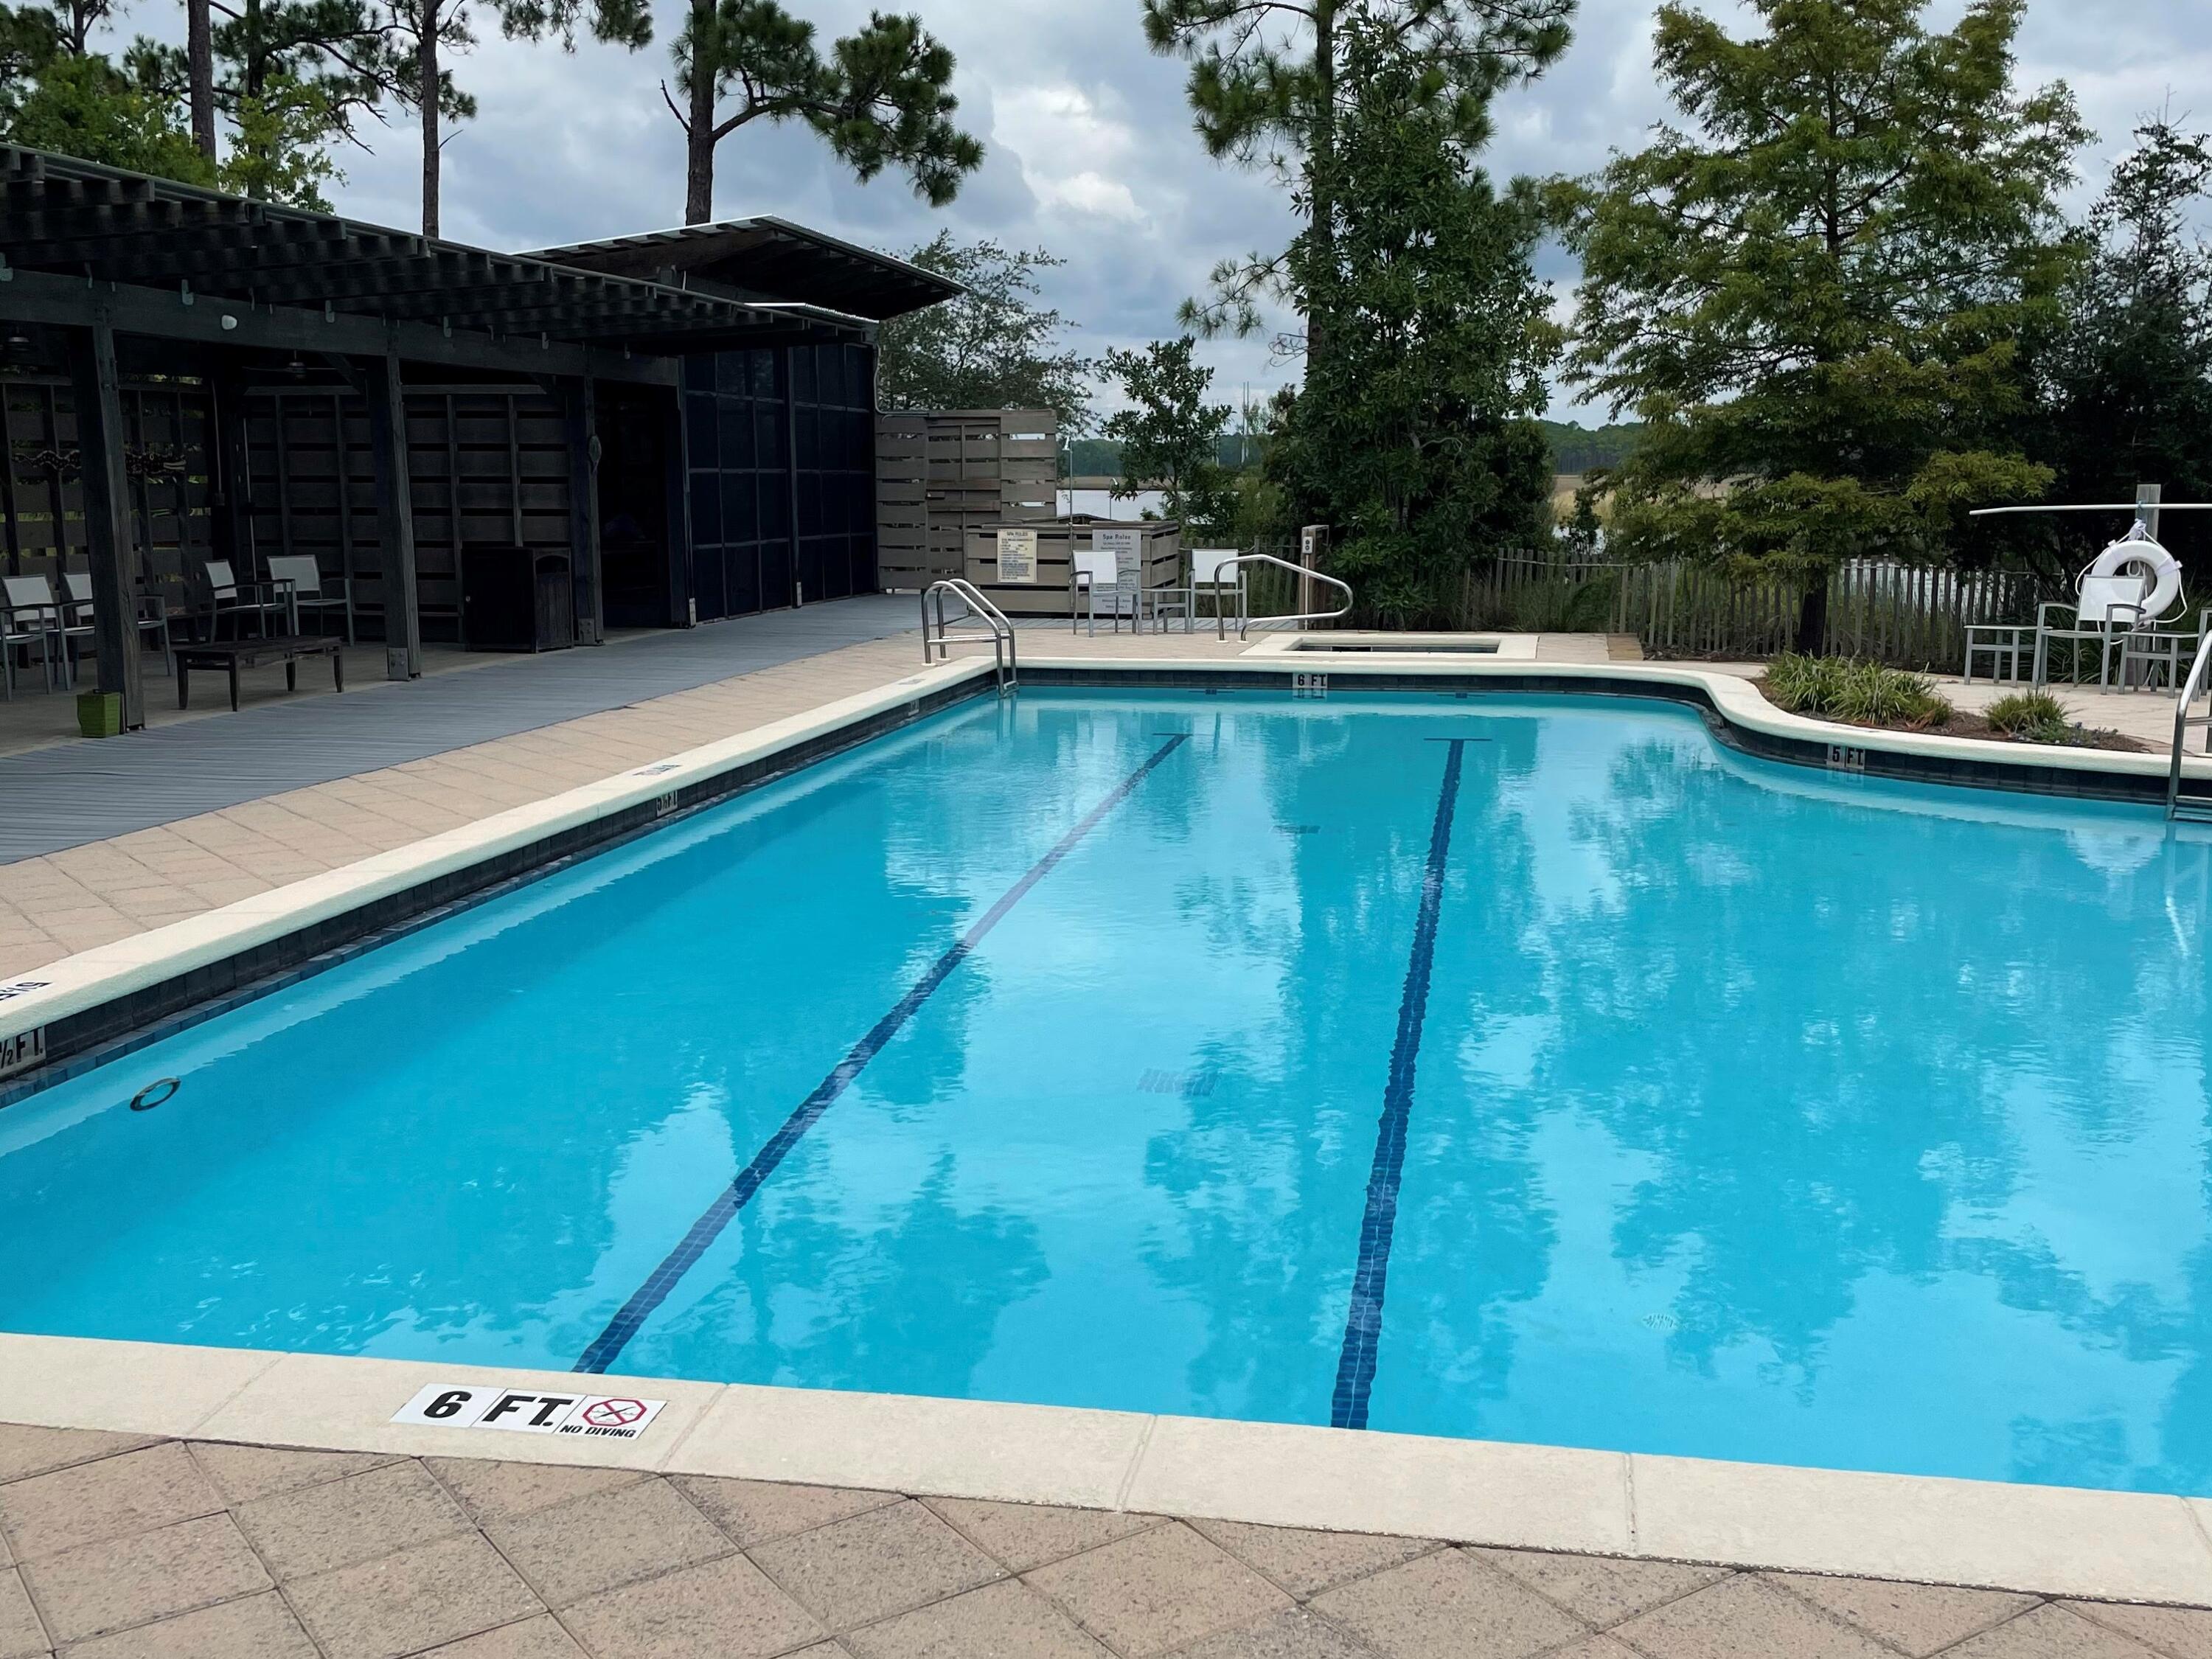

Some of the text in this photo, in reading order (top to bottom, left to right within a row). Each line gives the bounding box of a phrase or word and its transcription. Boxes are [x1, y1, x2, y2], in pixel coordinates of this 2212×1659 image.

[1298, 674, 1305, 686] 6
[1832, 745, 1841, 762] 5
[423, 1391, 574, 1427] 6 FT.
[559, 1425, 637, 1438] NO DIVING
